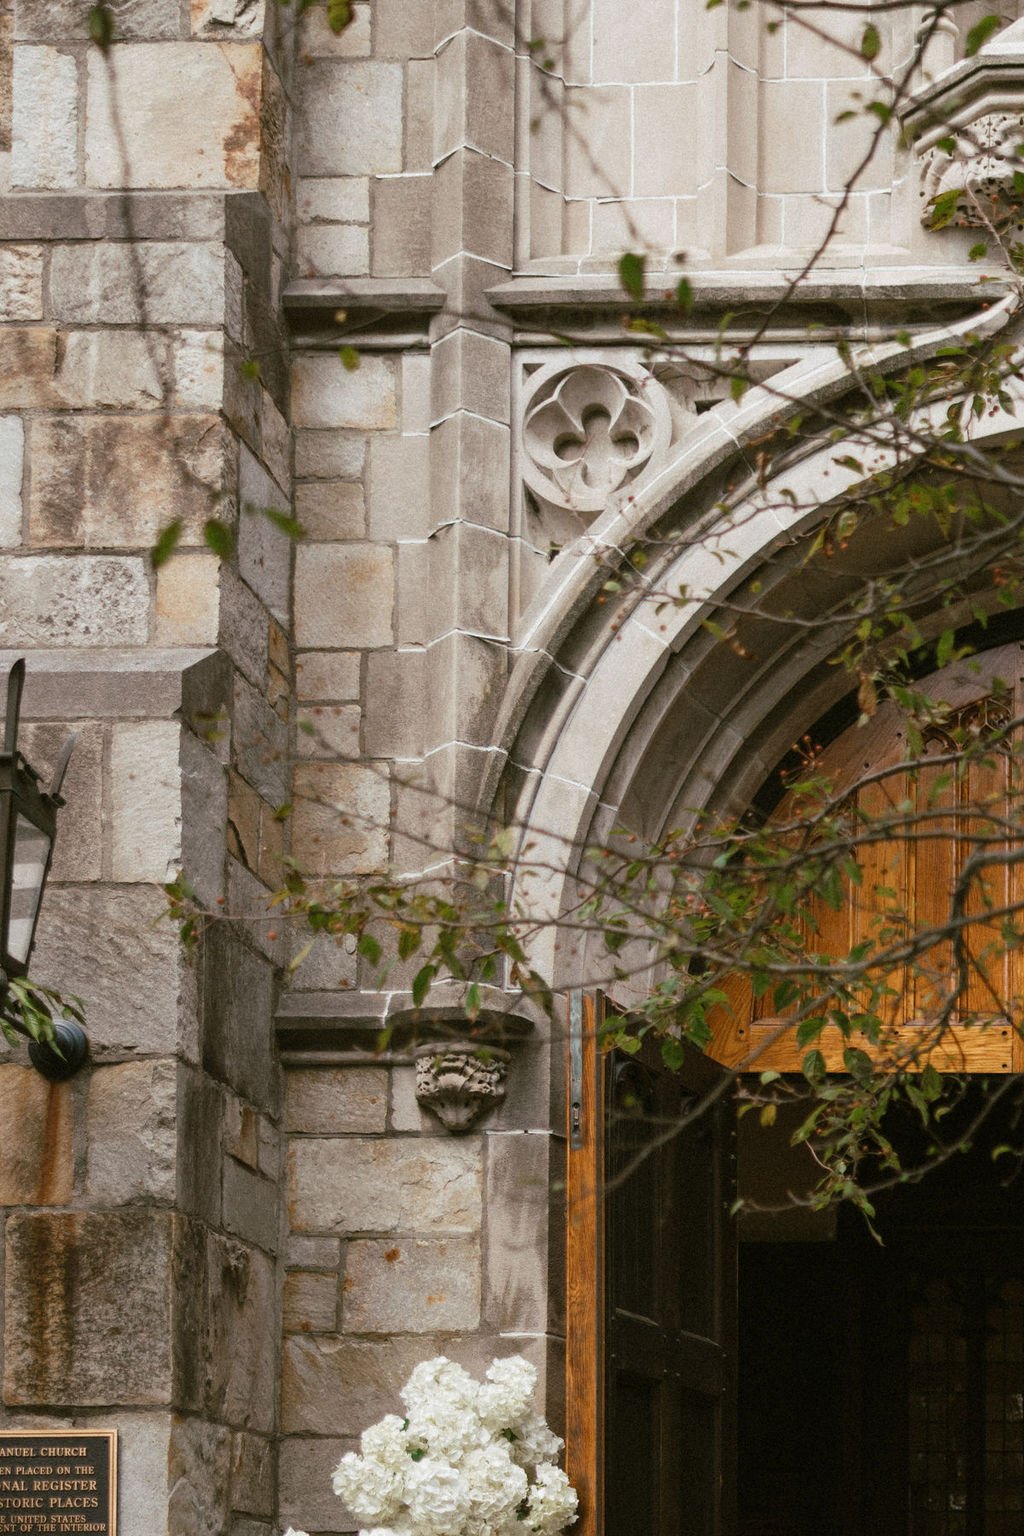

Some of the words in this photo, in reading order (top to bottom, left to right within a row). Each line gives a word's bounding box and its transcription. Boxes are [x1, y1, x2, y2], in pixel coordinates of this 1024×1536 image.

[0, 1447, 36, 1457] ANUEL
[40, 1447, 87, 1457] CHURCH
[16, 1466, 53, 1475] PLACED
[57, 1466, 71, 1475] ON
[75, 1466, 95, 1475] THE
[0, 1480, 28, 1491] NAL
[33, 1480, 97, 1491] REGISTER
[49, 1497, 99, 1508] PLACES
[10, 1515, 47, 1523] UNITED
[50, 1515, 87, 1523] STATES
[20, 1523, 34, 1532] OF
[37, 1523, 57, 1532] THE
[60, 1523, 106, 1532] INTERIOR
